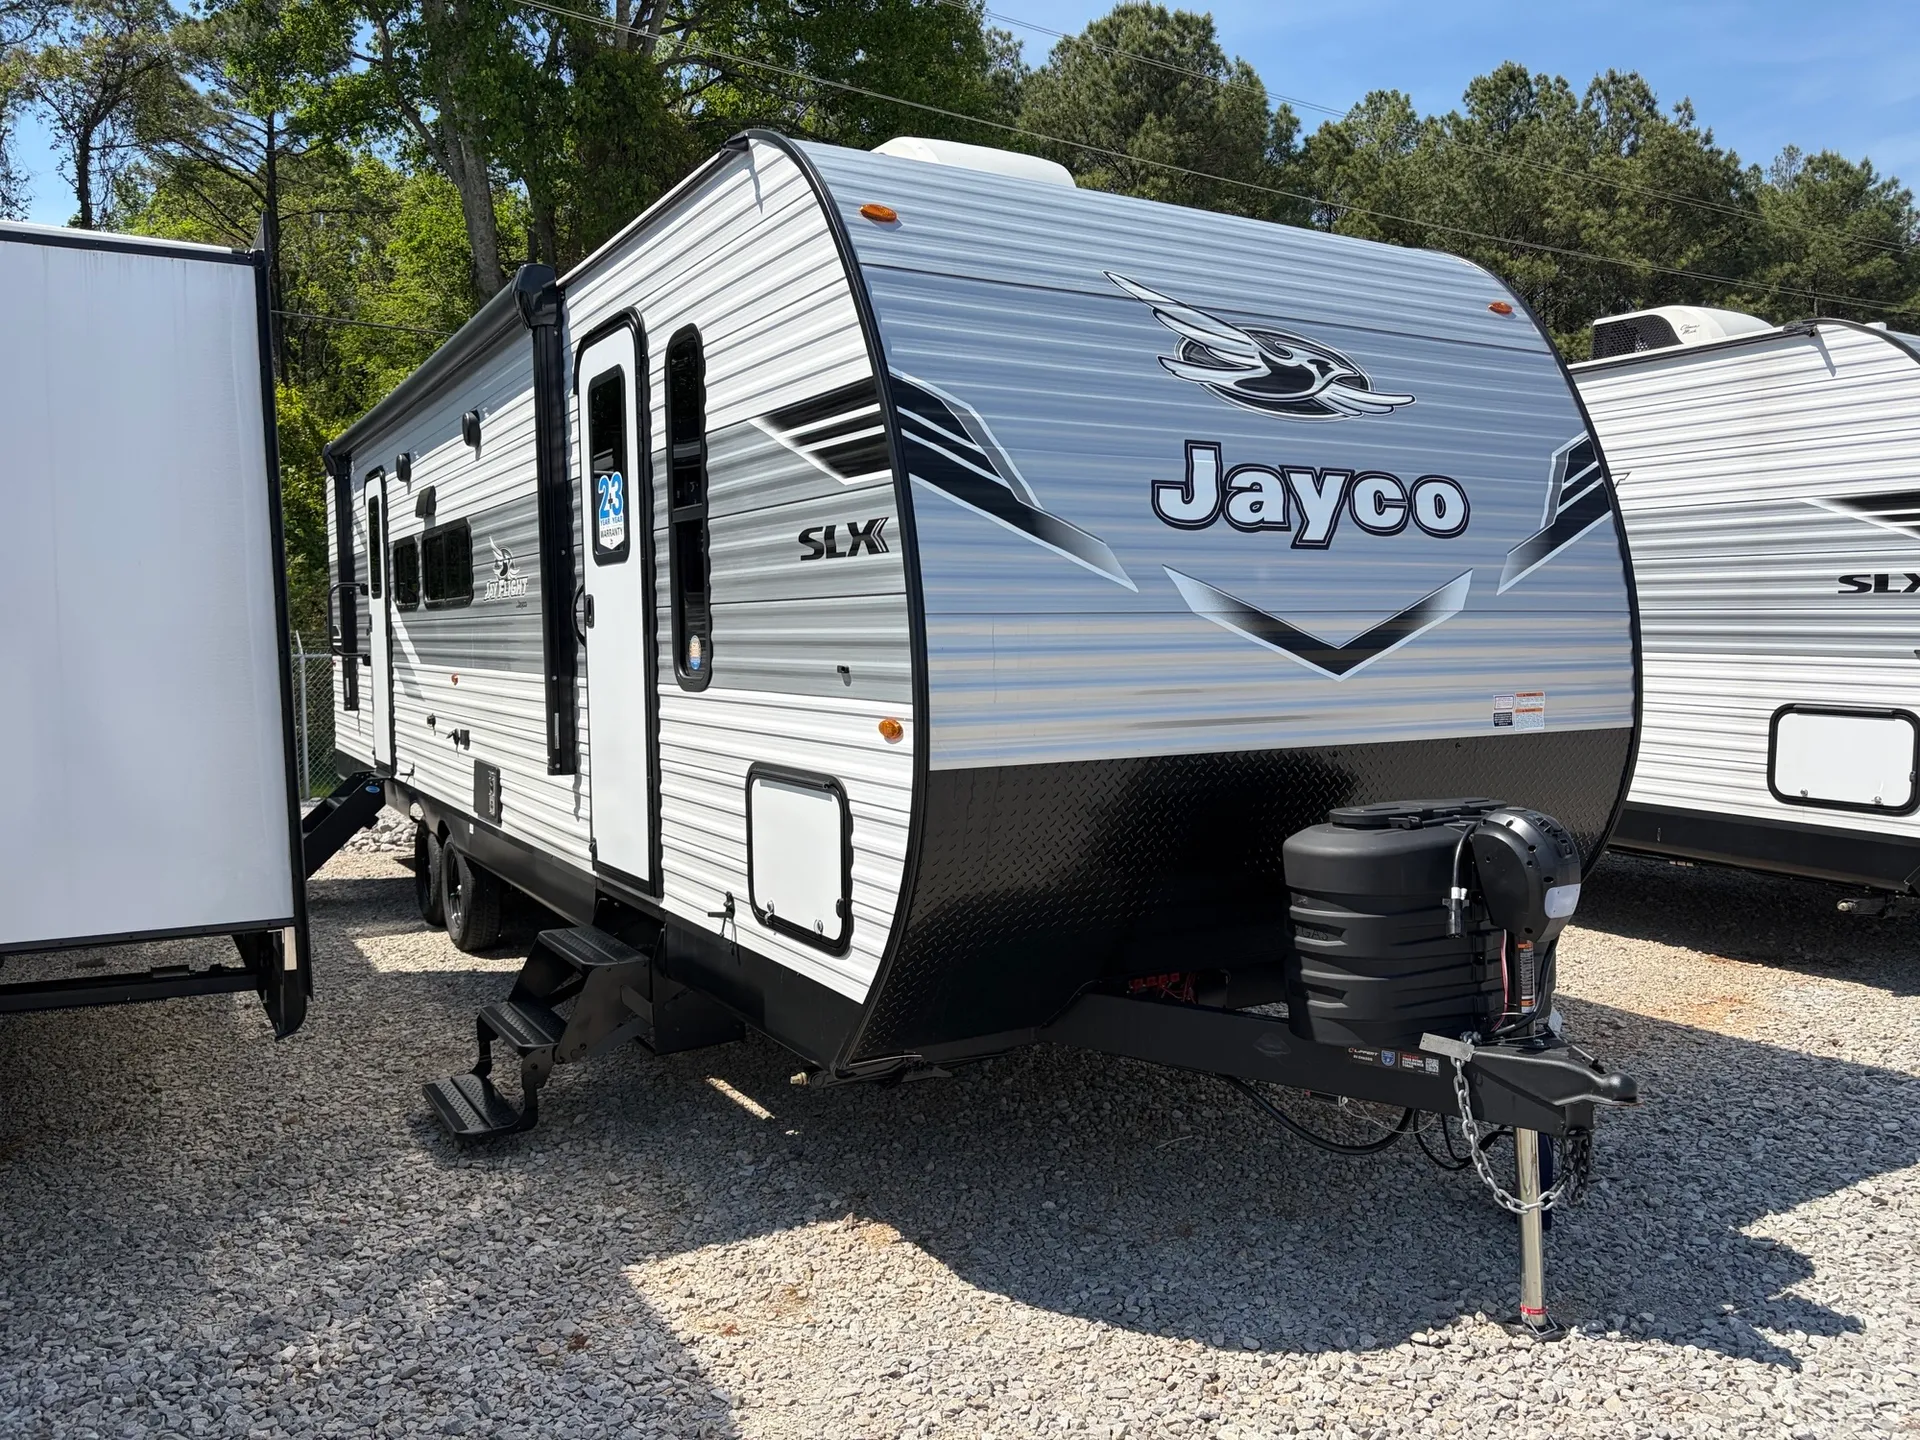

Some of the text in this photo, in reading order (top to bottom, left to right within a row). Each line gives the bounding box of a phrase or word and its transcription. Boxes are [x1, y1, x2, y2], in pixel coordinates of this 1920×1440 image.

[1151, 439, 1470, 550] Jayco
[600, 527, 623, 539] WARRANTY
[798, 516, 890, 561] SLX
[483, 576, 529, 602] JAY FLIGHT
